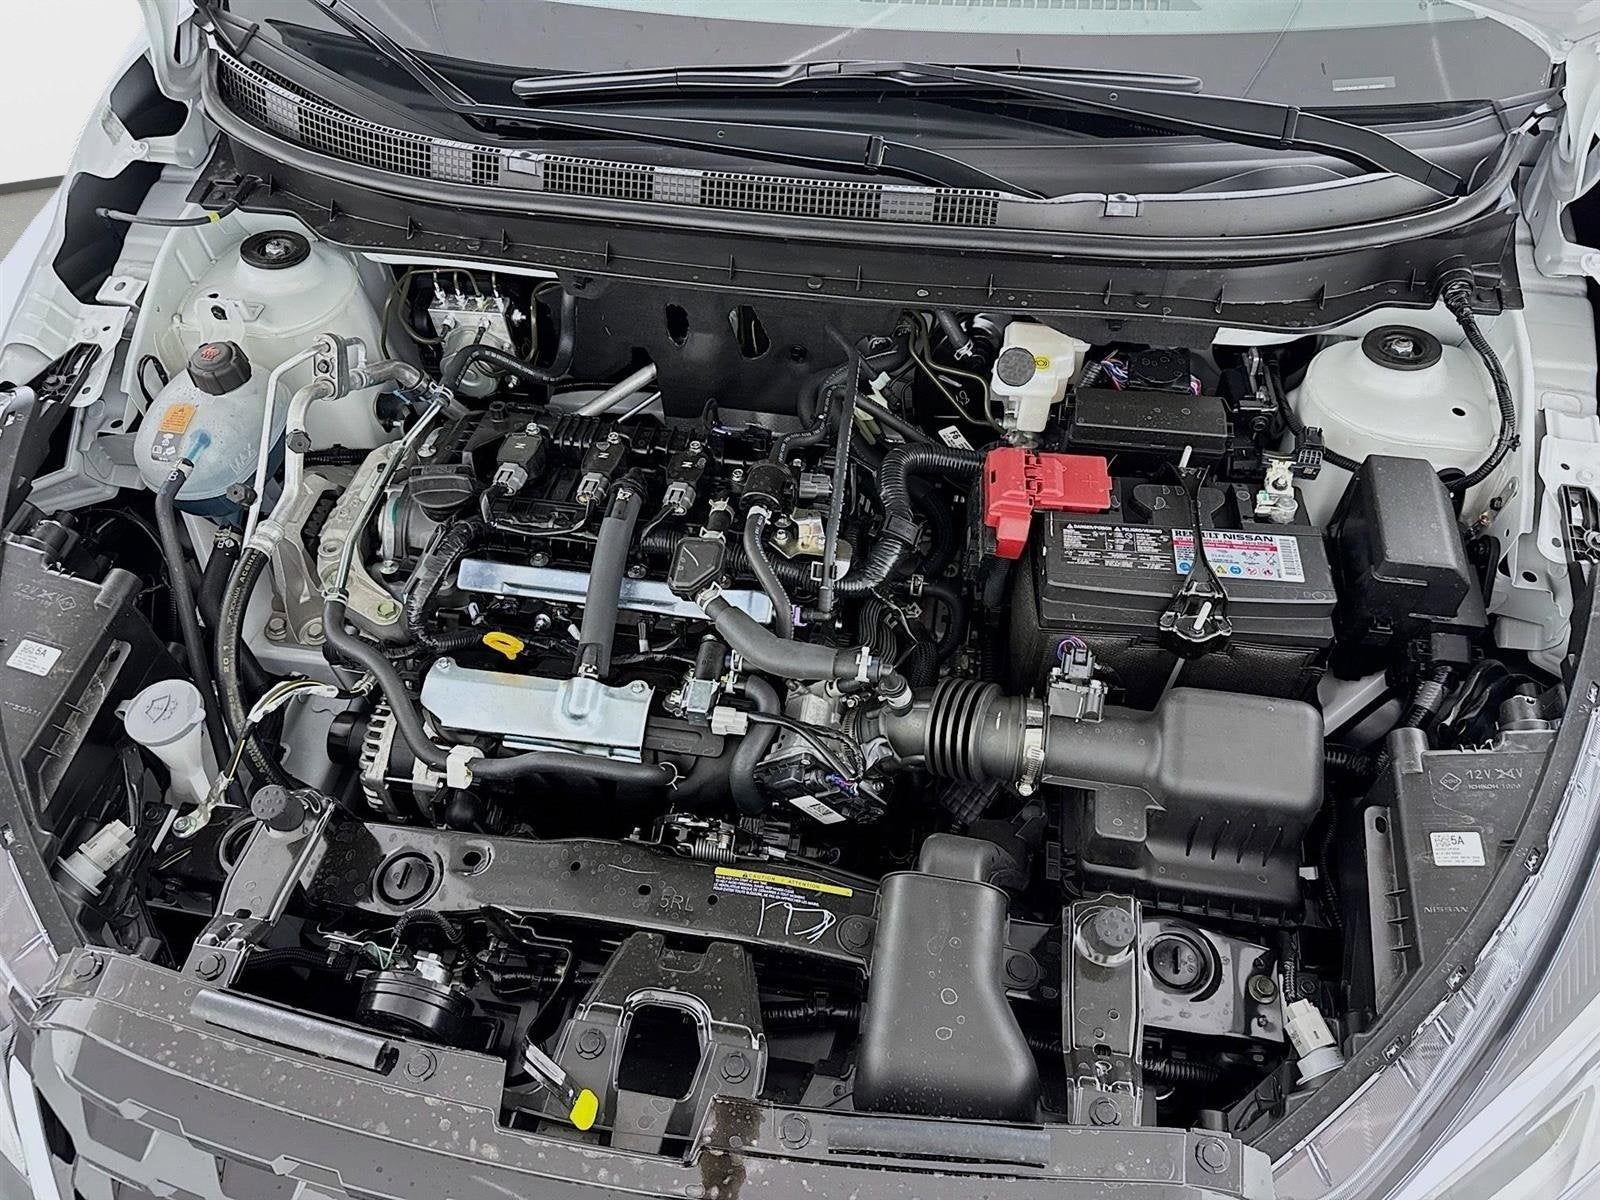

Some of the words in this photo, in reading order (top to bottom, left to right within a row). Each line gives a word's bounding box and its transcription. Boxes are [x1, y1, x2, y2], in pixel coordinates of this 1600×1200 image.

[1223, 533, 1273, 543] NISSAN
[1466, 769, 1491, 779] 12V
[1451, 835, 1464, 846] 5A
[748, 873, 775, 882] CAUTION
[788, 880, 820, 889] ATTENTION
